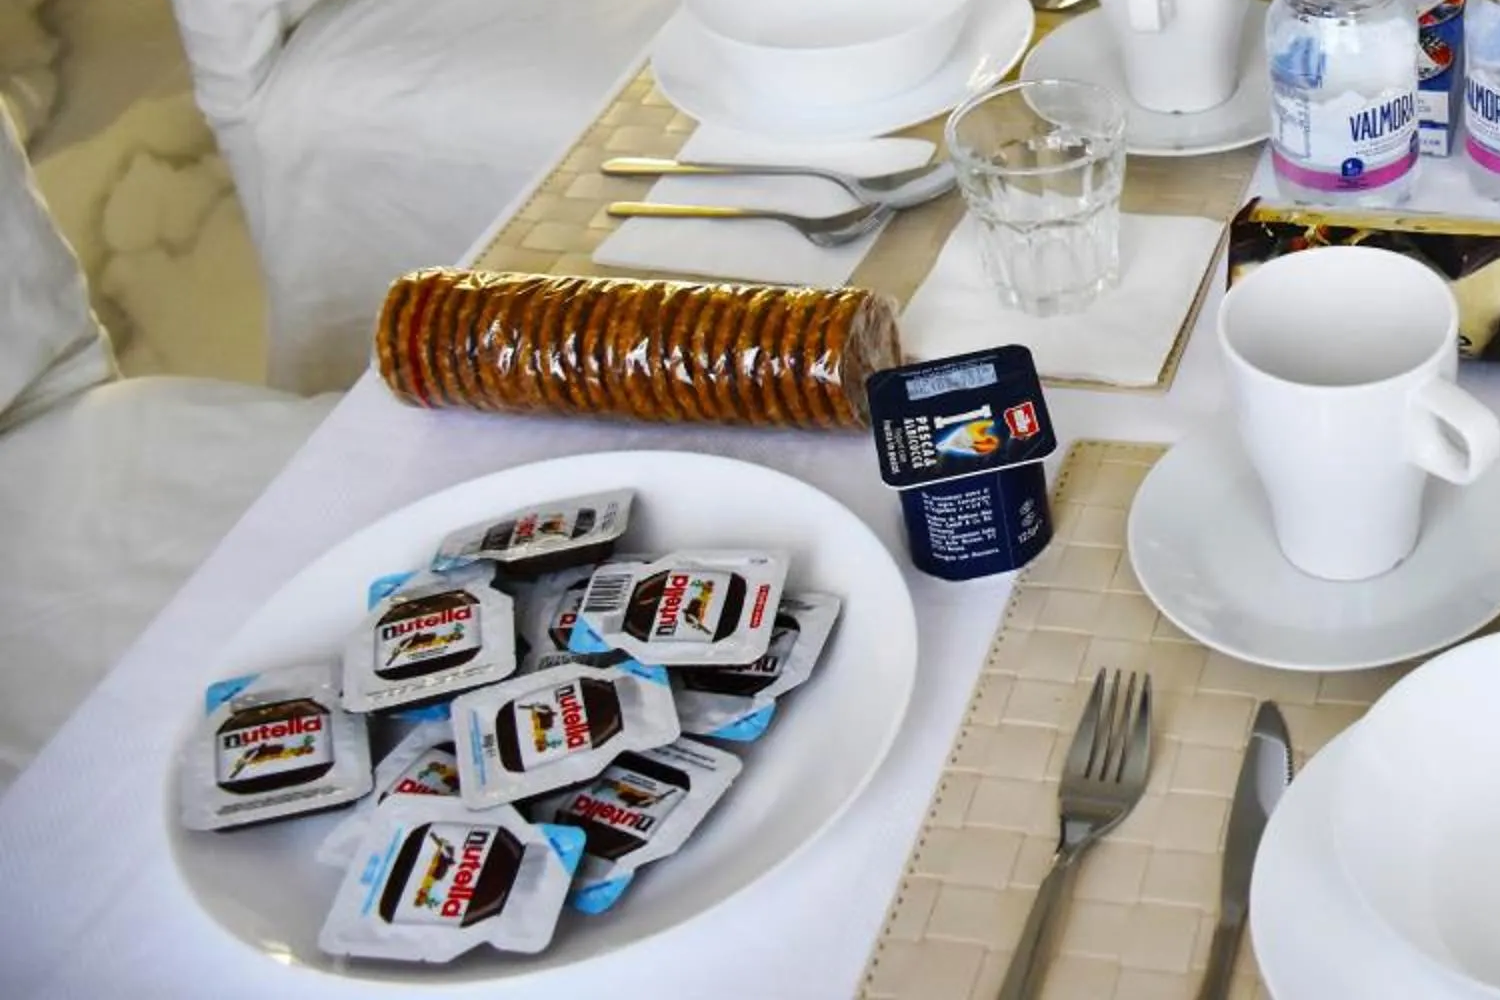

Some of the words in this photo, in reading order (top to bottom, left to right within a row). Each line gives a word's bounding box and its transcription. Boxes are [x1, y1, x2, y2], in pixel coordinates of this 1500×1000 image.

[904, 417, 923, 469] ALBICOCCA
[915, 415, 936, 458] PESCA
[382, 606, 472, 641] nutella
[656, 575, 689, 636] nutella
[223, 715, 322, 750] nutella
[554, 684, 592, 750] nutella
[574, 794, 657, 832] nutella
[440, 827, 490, 919] nutella
